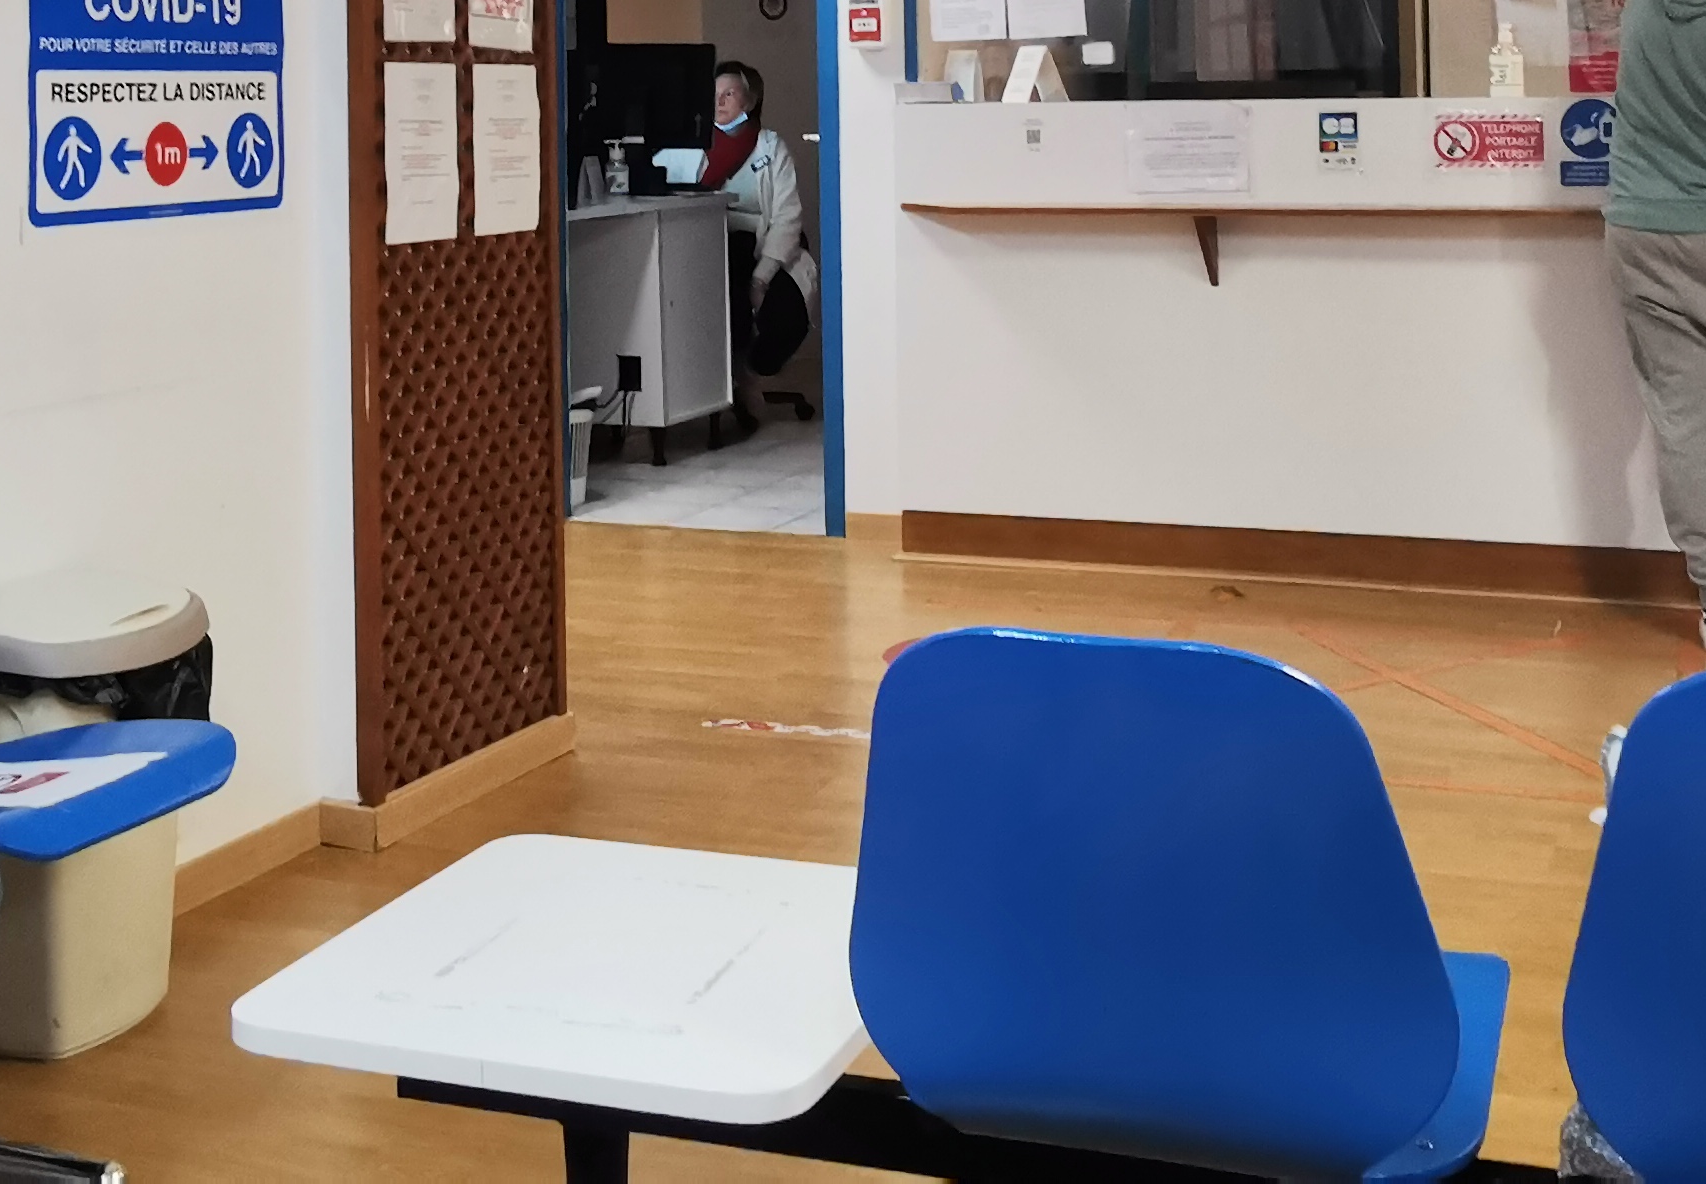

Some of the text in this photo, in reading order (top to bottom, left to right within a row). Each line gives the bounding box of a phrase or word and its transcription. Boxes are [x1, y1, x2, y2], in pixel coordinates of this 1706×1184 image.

[39, 36, 278, 56] POUR VOTRE SÉCURITÉ ET CELLE DES AUTRES
[51, 81, 266, 103] RESPECTEZ LA DISTANCE
[1485, 136, 1538, 146] PORTABLE
[155, 142, 182, 166] 1m
[1487, 149, 1535, 159] INTERDIT
